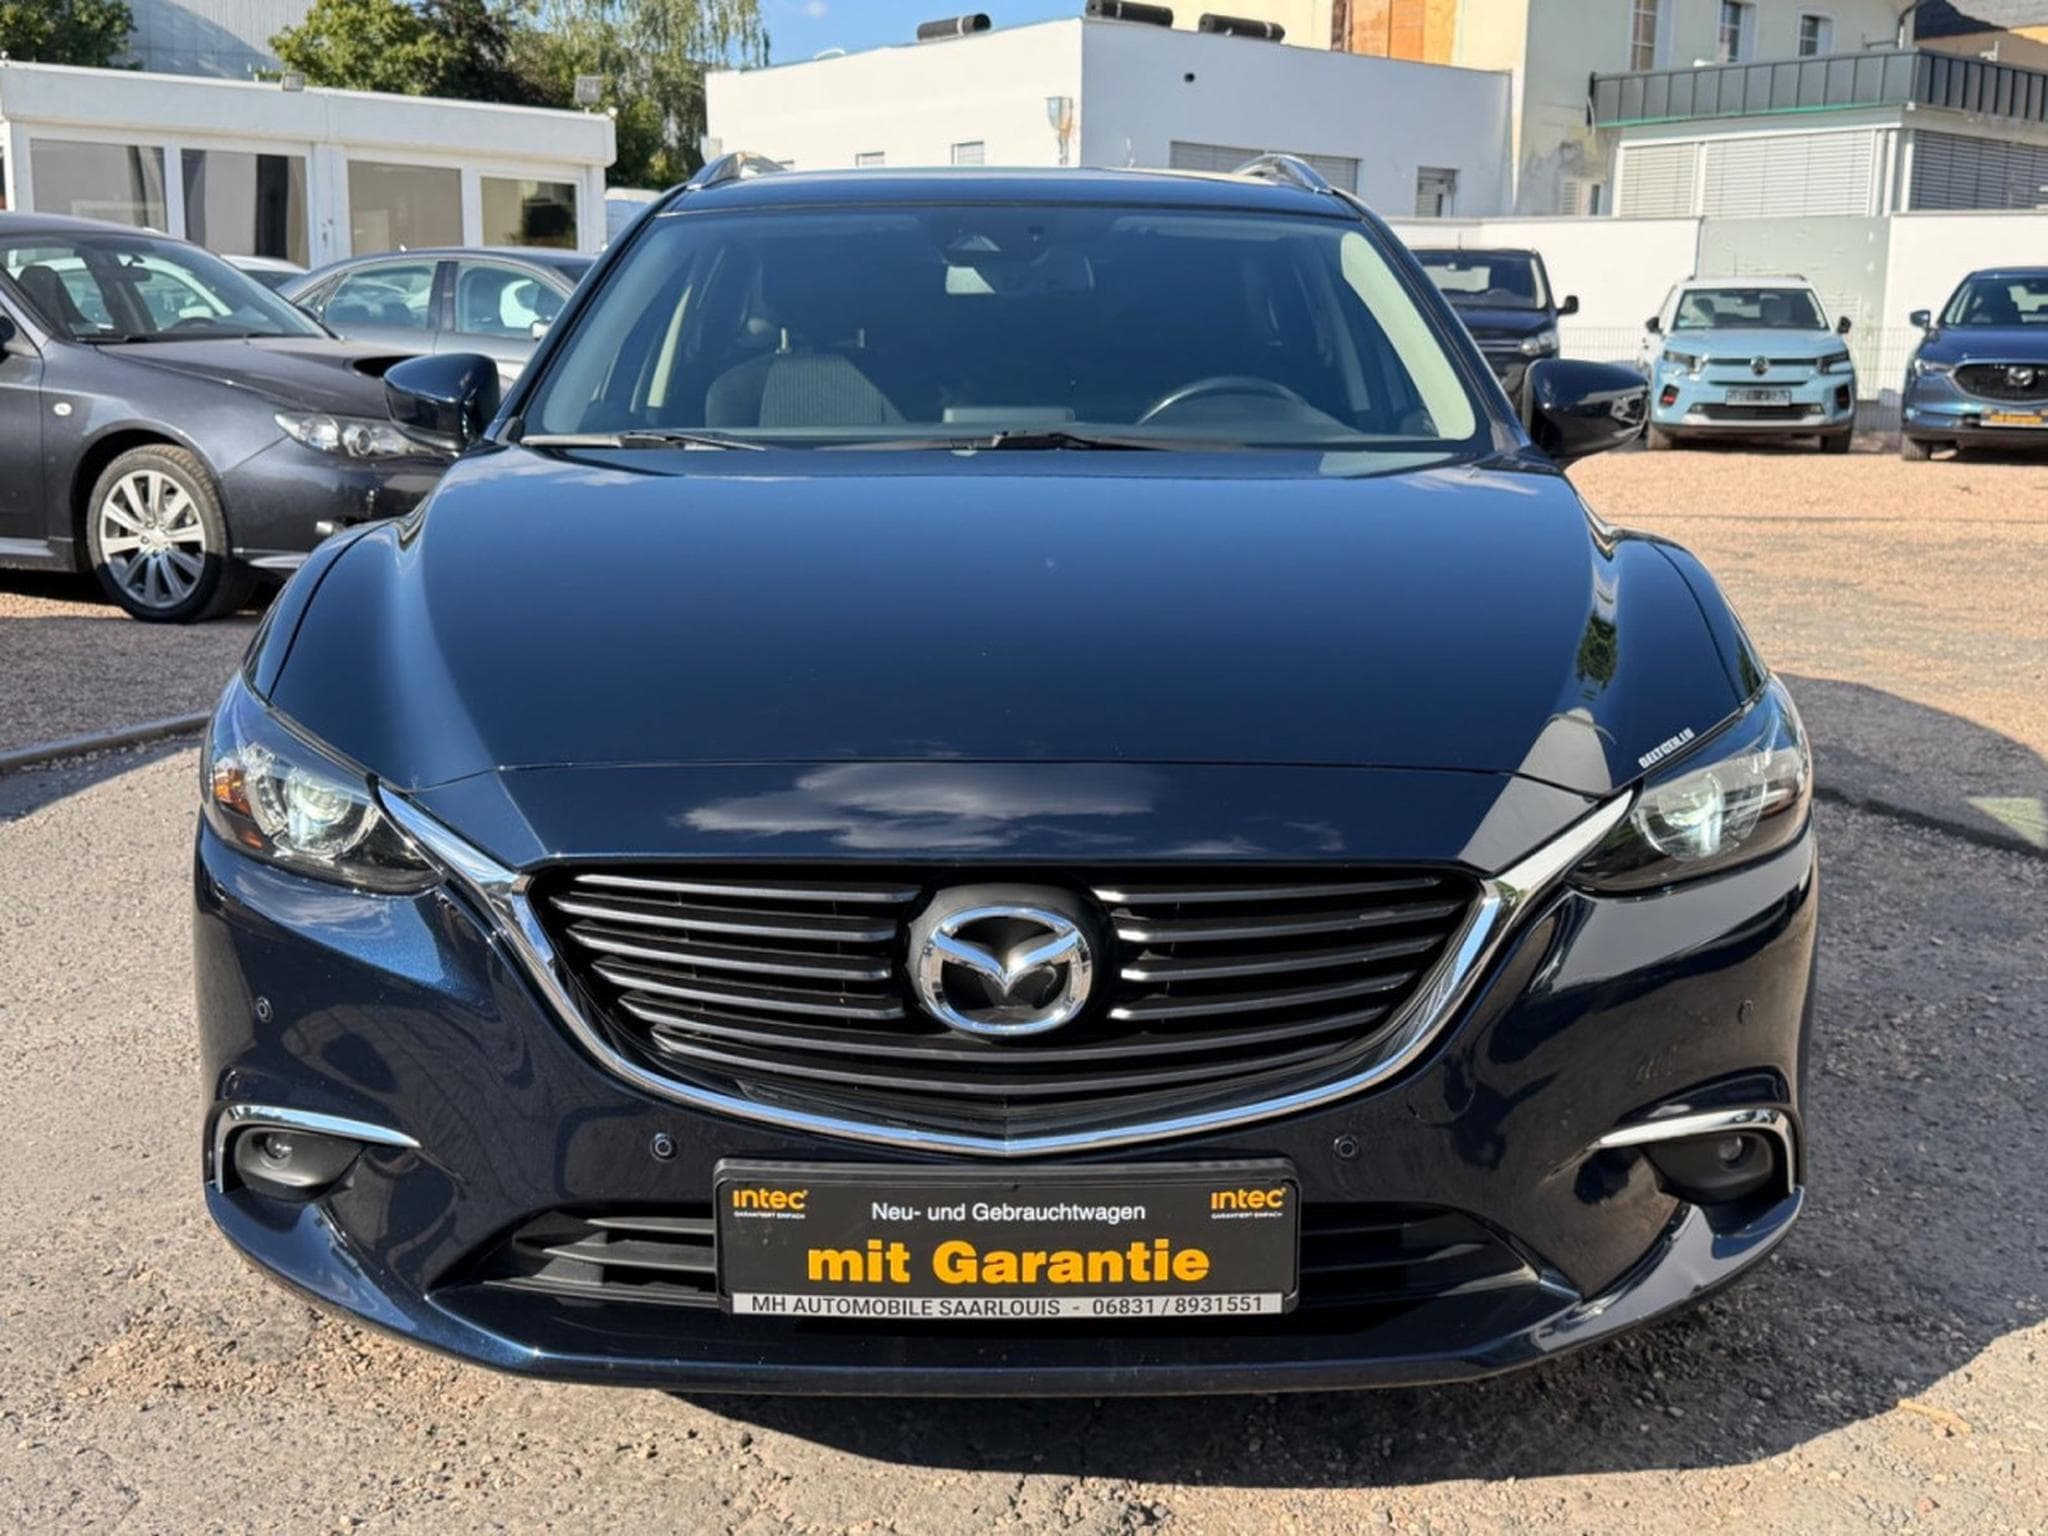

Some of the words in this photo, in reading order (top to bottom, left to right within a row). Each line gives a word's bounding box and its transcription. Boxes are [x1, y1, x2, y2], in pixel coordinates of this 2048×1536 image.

[733, 1188, 808, 1209] intec
[1211, 1187, 1287, 1210] intec
[871, 1202, 921, 1220] Neu-
[928, 1203, 965, 1221] und
[972, 1202, 1146, 1225] Gebrauchtwagen
[808, 1239, 911, 1283] mit
[933, 1239, 1210, 1284] Garantie
[751, 1295, 786, 1312] MH
[793, 1297, 933, 1316] AUTOMOBILE
[939, 1299, 1061, 1316] SAARLOUIS
